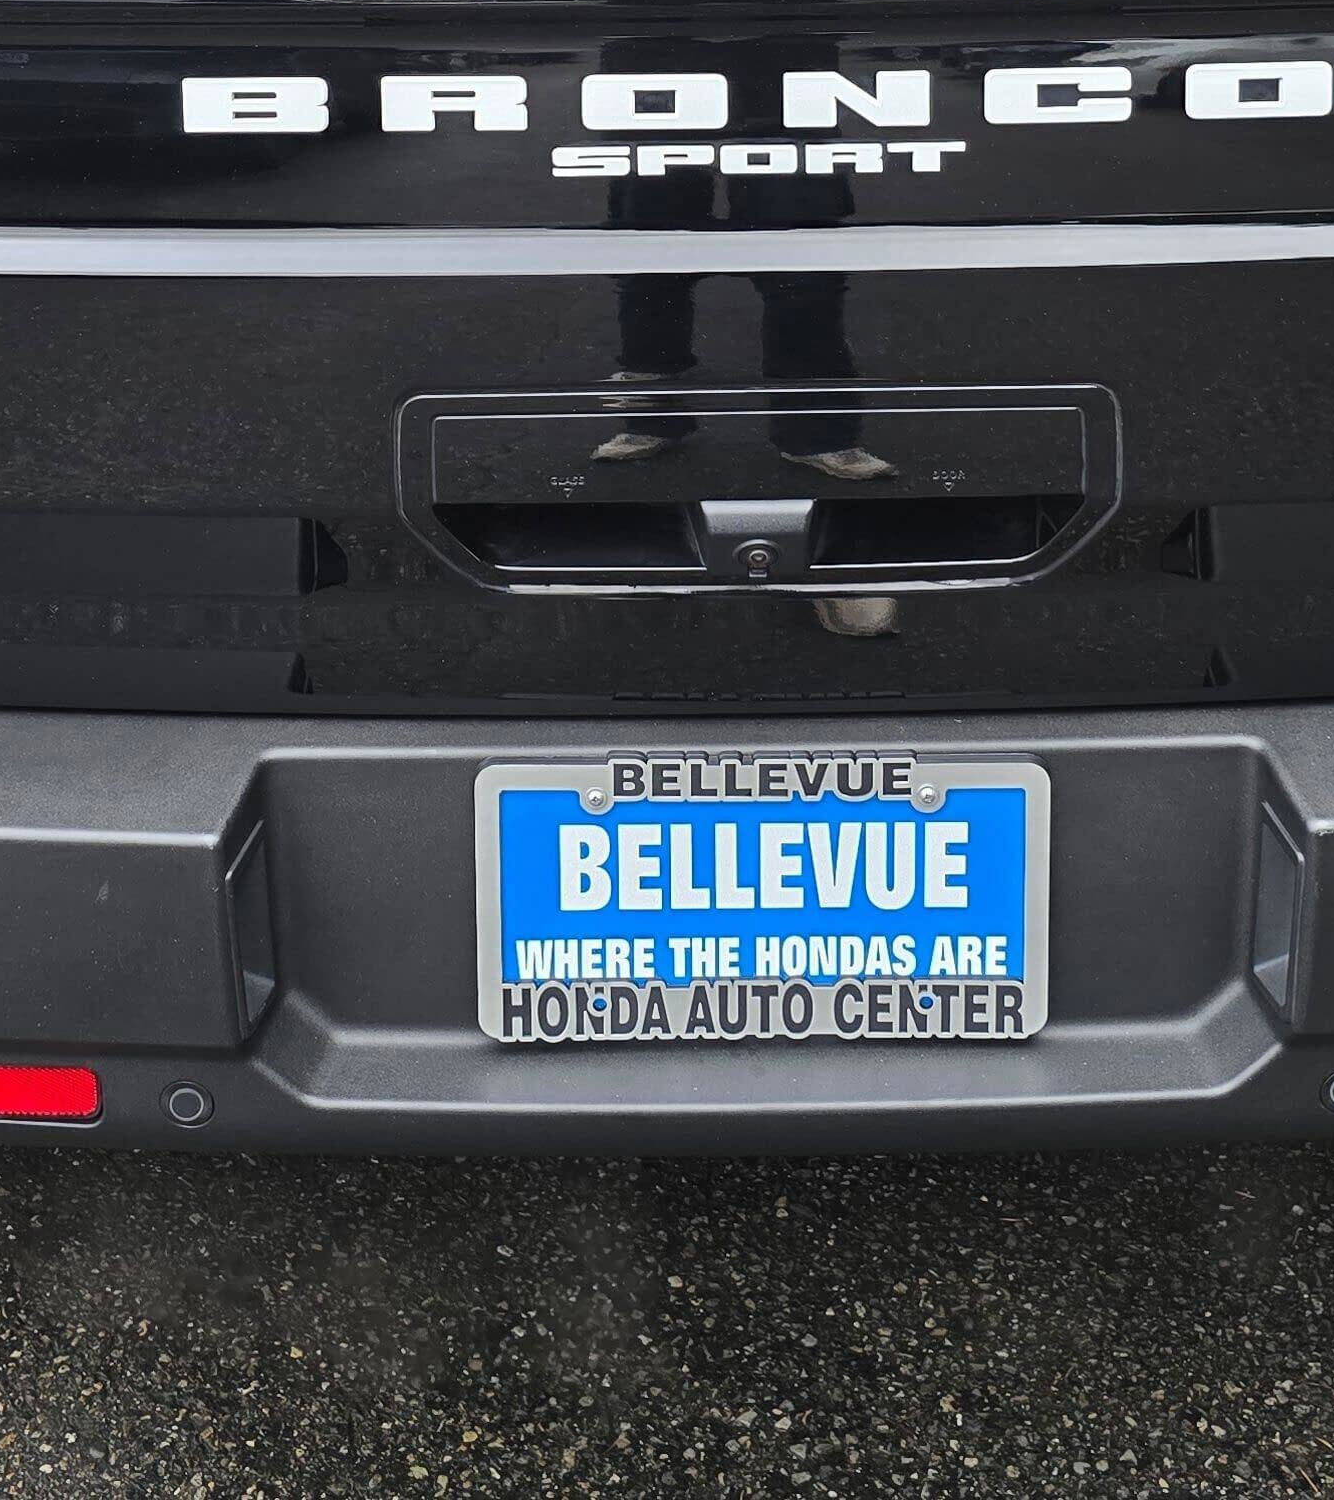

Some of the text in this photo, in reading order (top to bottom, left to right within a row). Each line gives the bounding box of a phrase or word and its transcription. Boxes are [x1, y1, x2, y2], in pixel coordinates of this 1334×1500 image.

[180, 59, 1334, 134] BRONCO
[550, 140, 967, 179] SPORT
[611, 763, 913, 798] BELLEVUE
[558, 821, 969, 912] BELLEVUE
[516, 934, 1007, 979] WHERE THE HONDAS ARE
[502, 983, 1024, 1038] HONDA AUTO CENTER
